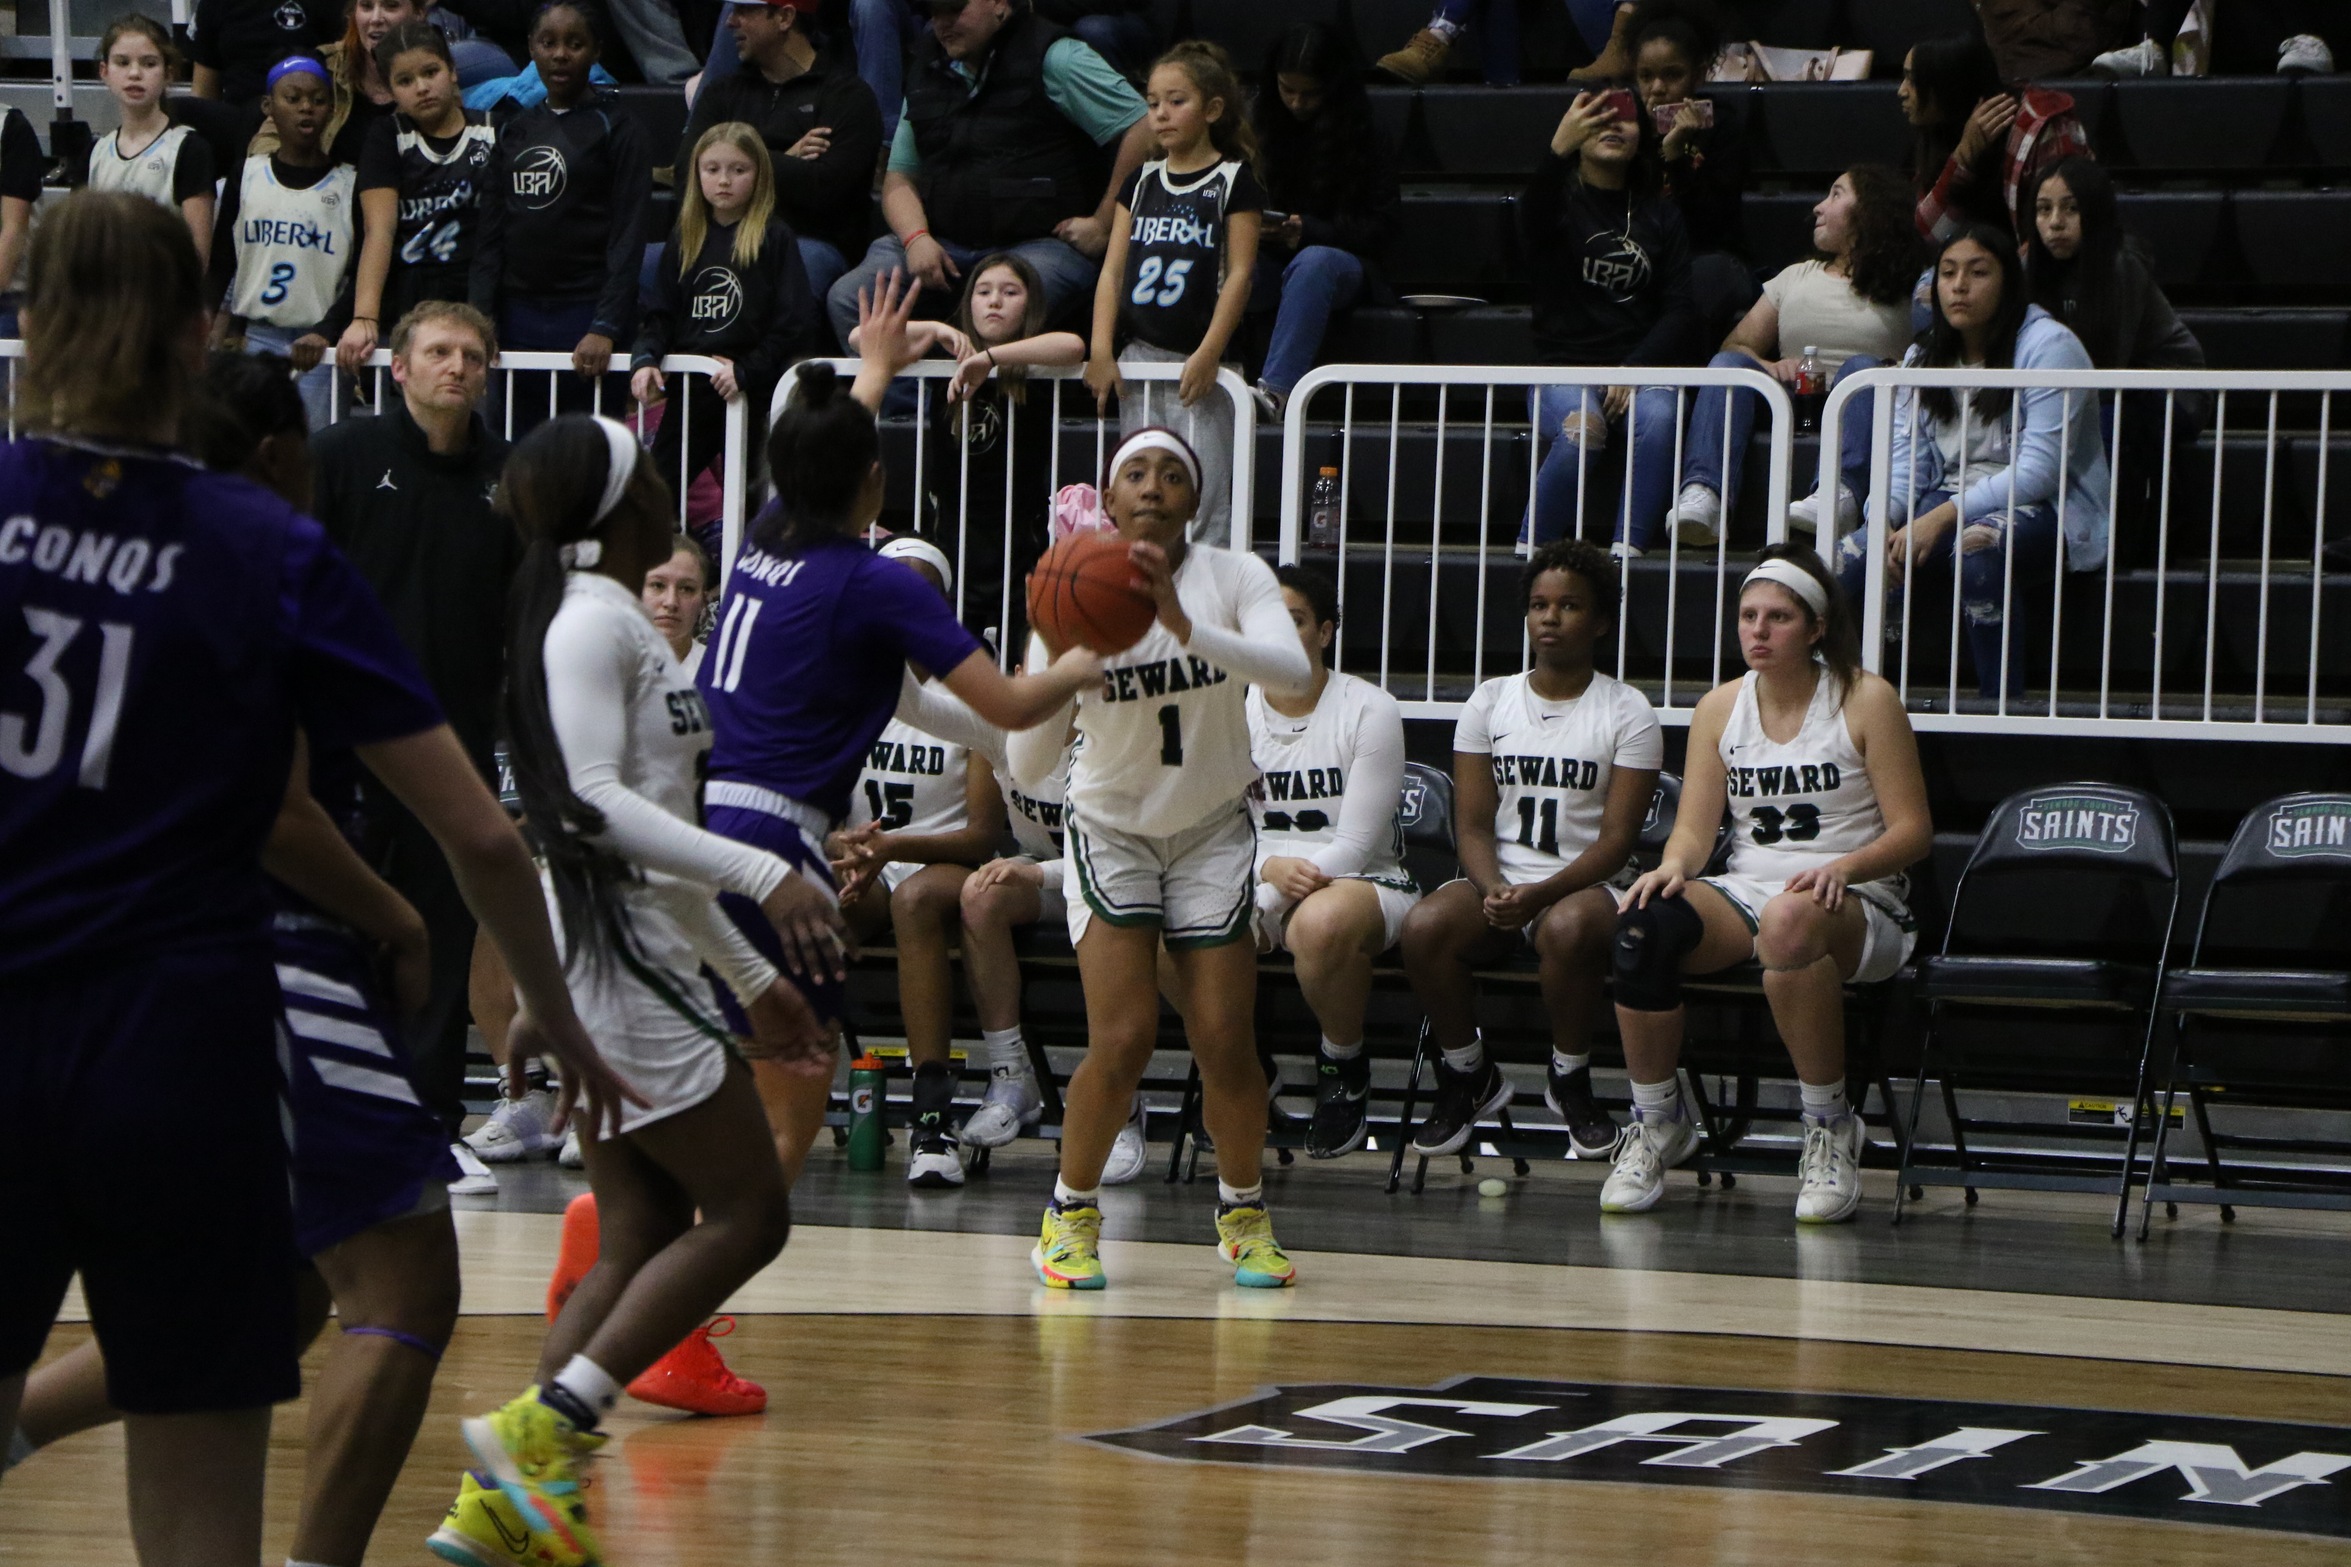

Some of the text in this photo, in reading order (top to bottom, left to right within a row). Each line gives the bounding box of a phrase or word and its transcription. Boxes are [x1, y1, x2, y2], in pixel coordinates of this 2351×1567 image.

[261, 263, 296, 305] 3
[1131, 255, 1194, 307] 25
[0, 514, 186, 595] CONQS
[711, 592, 763, 692] 11
[0, 604, 135, 791] 31
[1158, 704, 1183, 766] 1
[1493, 755, 1598, 791] SEWARD
[1729, 762, 1841, 797] SEWARD
[865, 779, 914, 831] 15
[1516, 797, 1559, 857] 11
[1749, 803, 1820, 845] 33
[2024, 810, 2132, 843] SAINTS
[2274, 816, 2351, 848] SAIN
